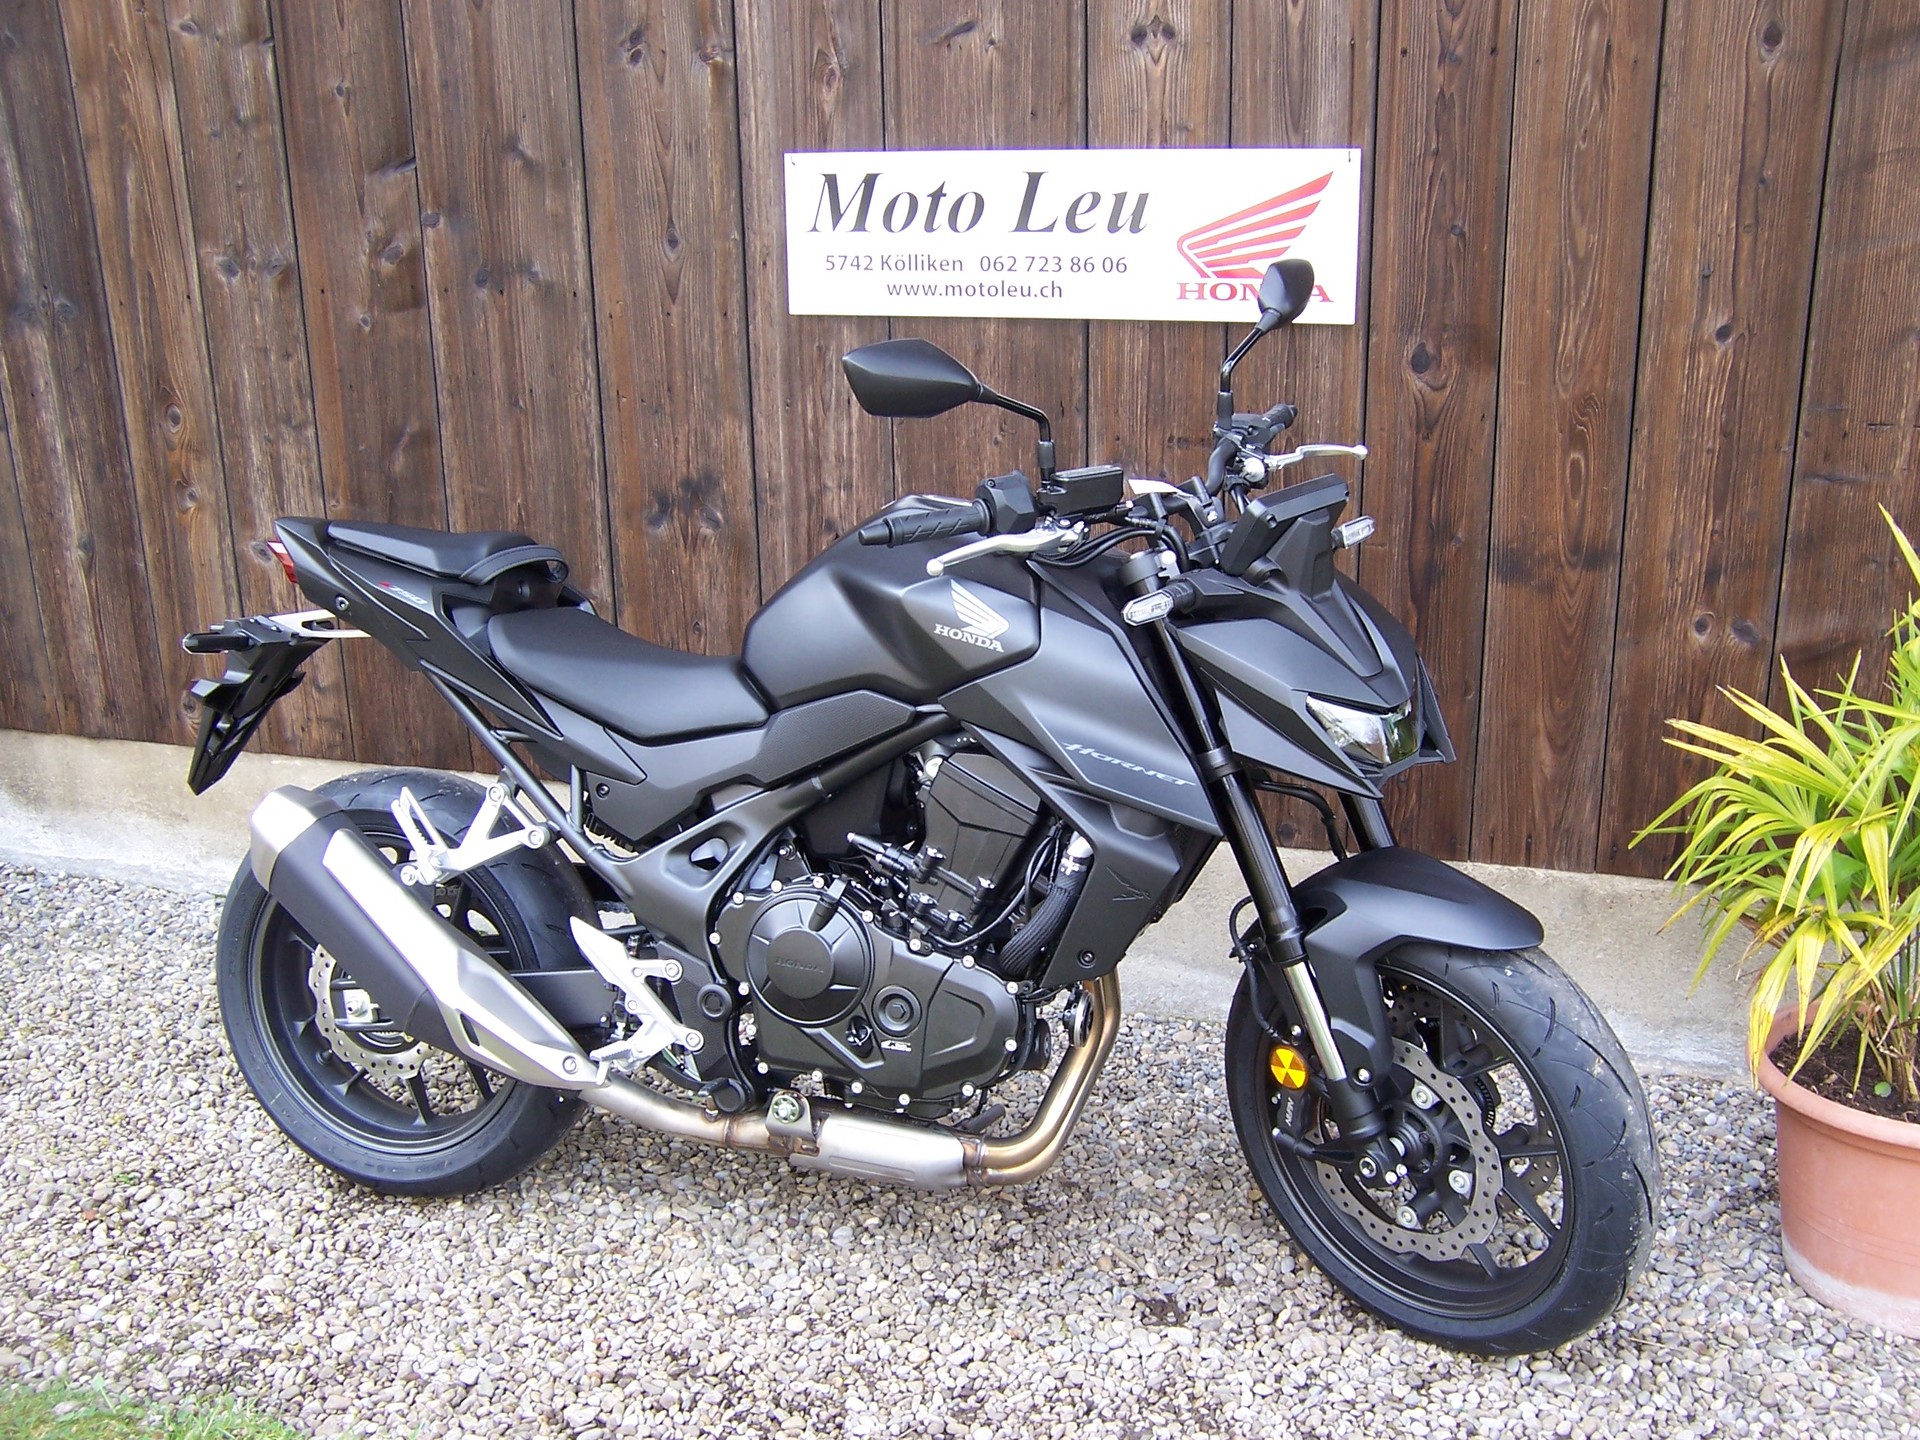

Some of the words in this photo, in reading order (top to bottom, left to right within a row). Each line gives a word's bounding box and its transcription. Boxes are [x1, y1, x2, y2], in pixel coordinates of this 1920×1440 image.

[807, 172, 984, 234] Moto
[1010, 171, 1150, 234] Leu
[826, 255, 874, 271] 5742
[880, 253, 963, 272] Kölliken
[979, 255, 1018, 272] 062
[1024, 256, 1062, 273] 723
[1069, 256, 1095, 273] 86
[1102, 256, 1128, 274] 06
[886, 279, 1063, 299] www.motoleu.ch
[1176, 282, 1334, 303] HONA
[933, 623, 1005, 653] HONDA
